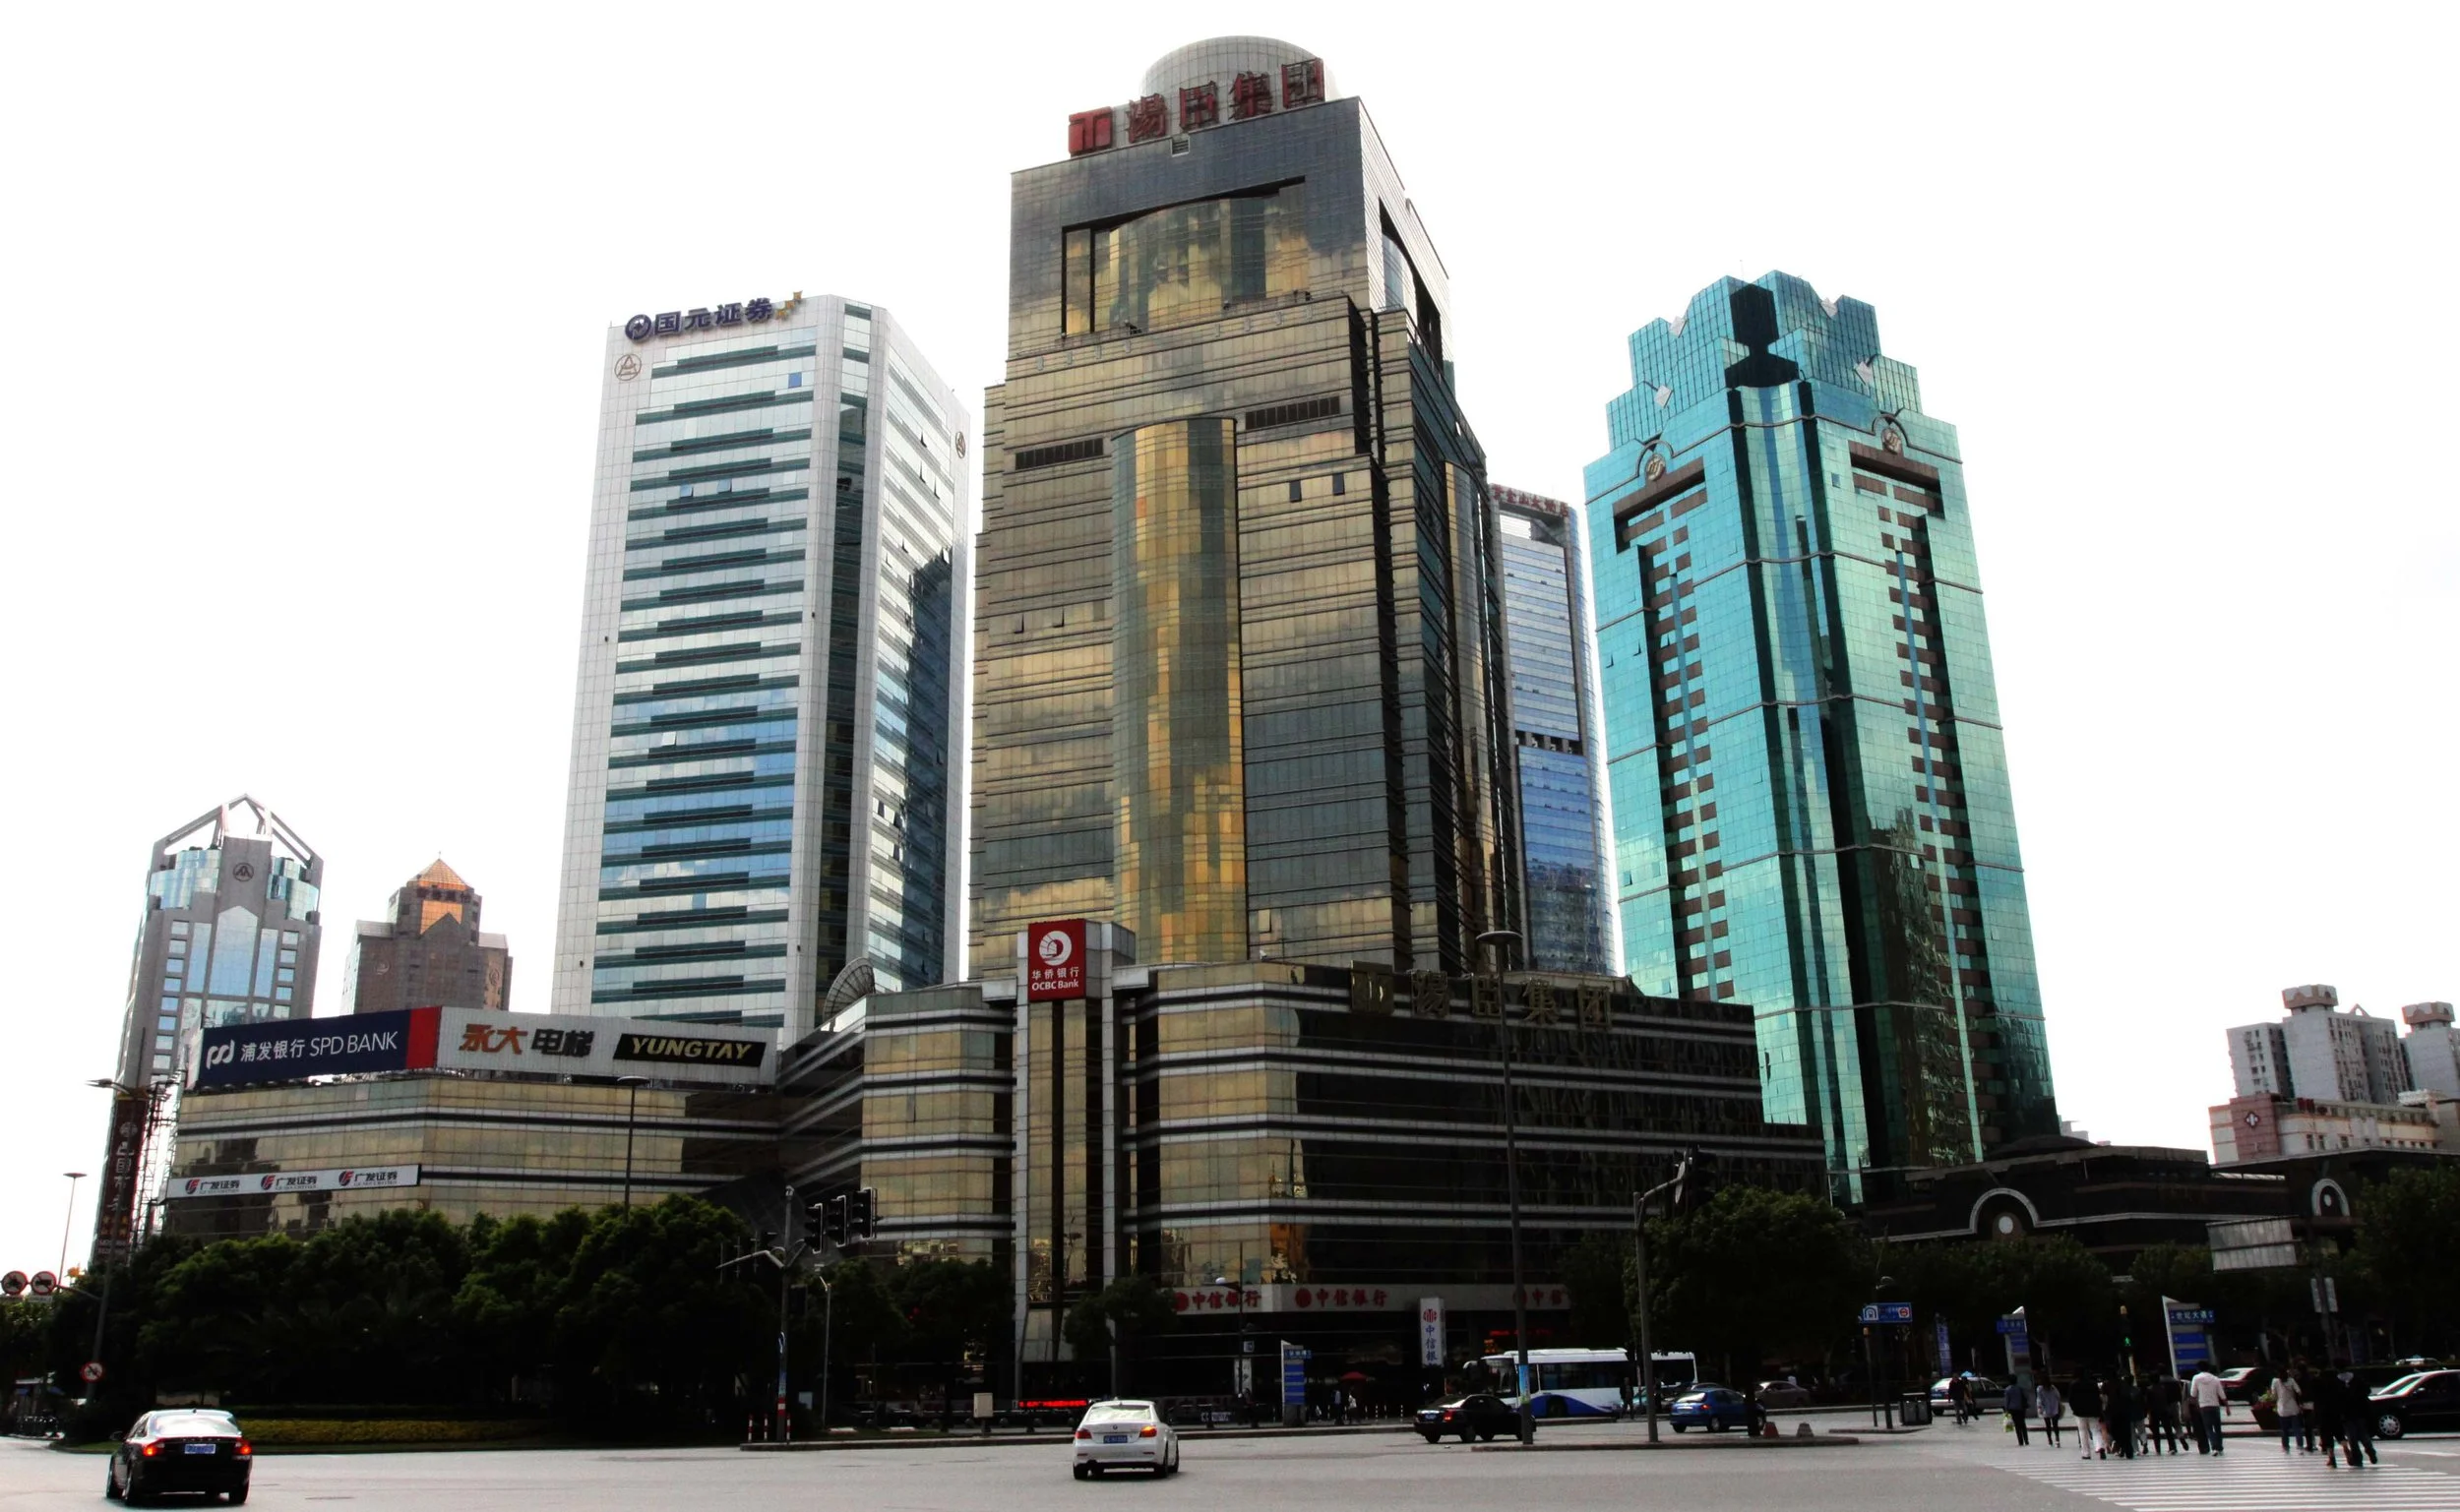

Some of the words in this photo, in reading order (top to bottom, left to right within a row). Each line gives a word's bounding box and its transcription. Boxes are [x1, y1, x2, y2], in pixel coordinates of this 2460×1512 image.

[654, 297, 772, 335] 国元证券
[1031, 966, 1079, 980] 华侨银行
[1031, 981, 1056, 991] OCBC
[1058, 979, 1078, 989] Bank
[240, 1038, 305, 1062] 浦发银行
[310, 1036, 344, 1057] SPD
[346, 1030, 398, 1054] BANK
[459, 1023, 594, 1058] 永大电梯
[630, 1037, 754, 1059] YUNGTAY
[199, 1179, 240, 1190] 广发证券
[276, 1176, 318, 1186] 广发证券
[354, 1171, 398, 1181] 广发证券
[1192, 1290, 1261, 1309] 中信银行
[1317, 1289, 1386, 1306] 中信银行
[1426, 1325, 1438, 1367] 中信银
